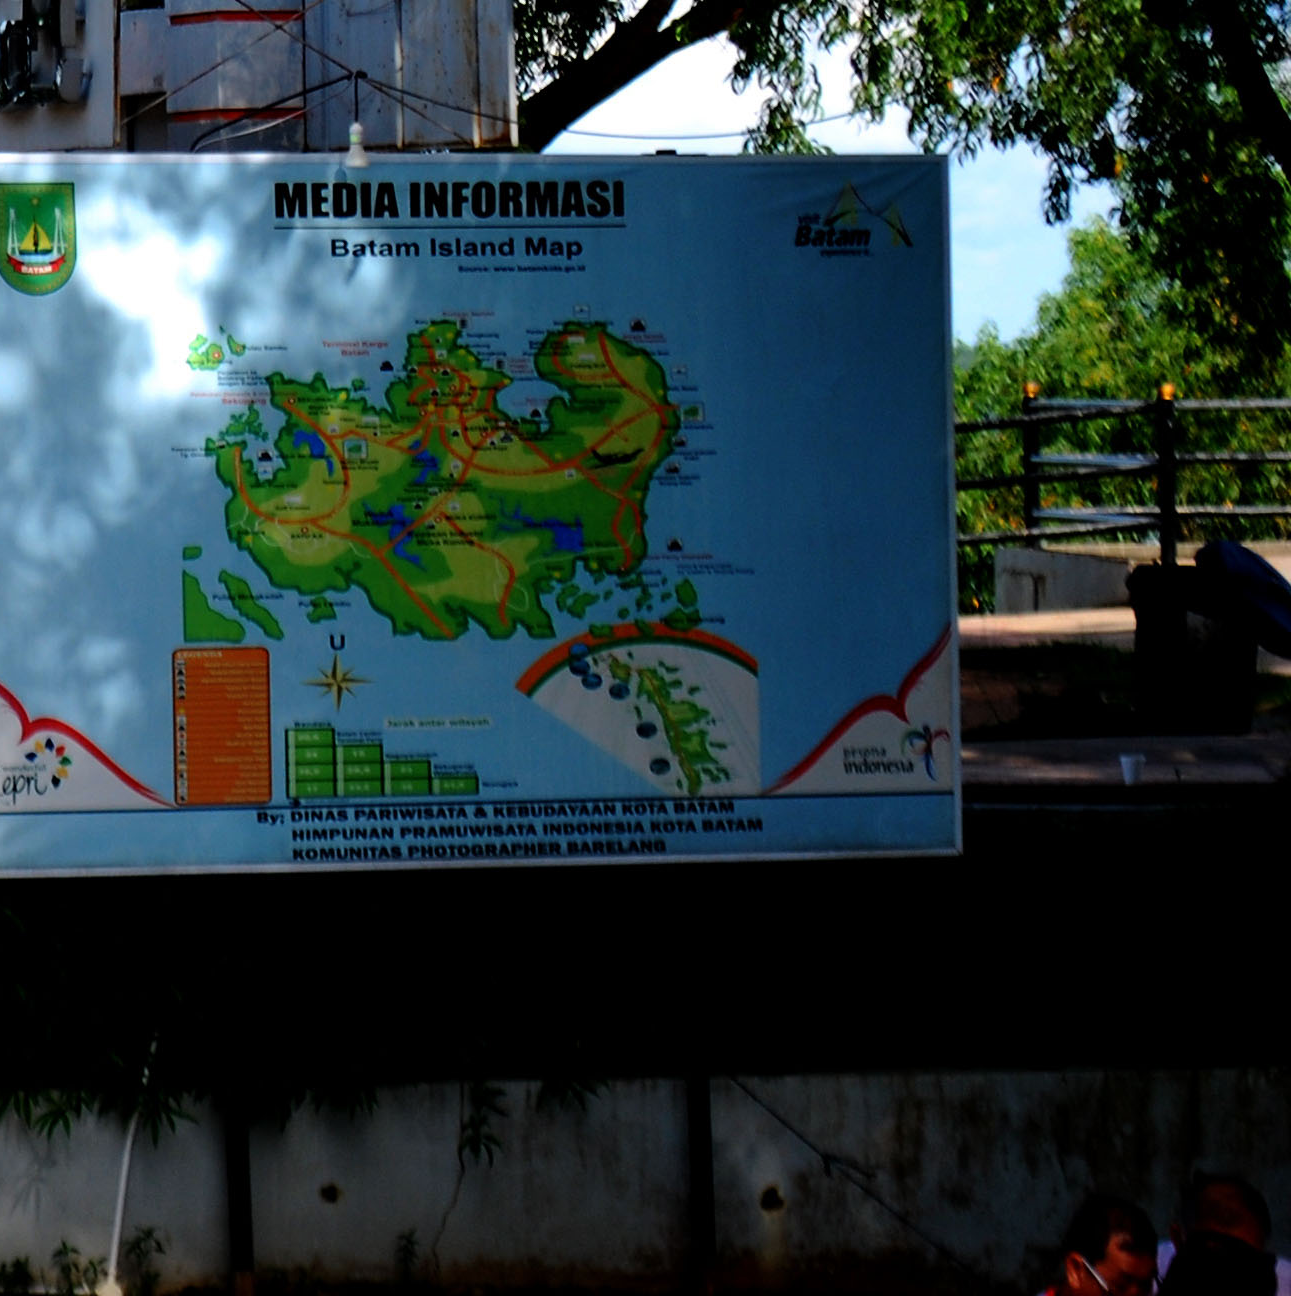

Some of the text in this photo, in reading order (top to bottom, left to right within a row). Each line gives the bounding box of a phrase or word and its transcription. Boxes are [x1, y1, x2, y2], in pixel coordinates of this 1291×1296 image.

[274, 181, 625, 218] MEDIA INFORMASI
[795, 224, 871, 247] Batam
[330, 237, 583, 260] Batam Island Map
[330, 634, 345, 651] U
[290, 809, 349, 823] DINAS
[354, 807, 468, 821] PARIWISATA
[473, 806, 487, 819] &
[493, 803, 617, 819] KEBUDAYAAN
[622, 801, 668, 816] KOTA
[673, 800, 735, 815] BATAM
[292, 818, 764, 842] HIMPUNAN PRAMUWISATA INDONESIA KOTA BATAM
[292, 839, 667, 862] KOMUNITAS PHOTOGRAPHER BARELANG
